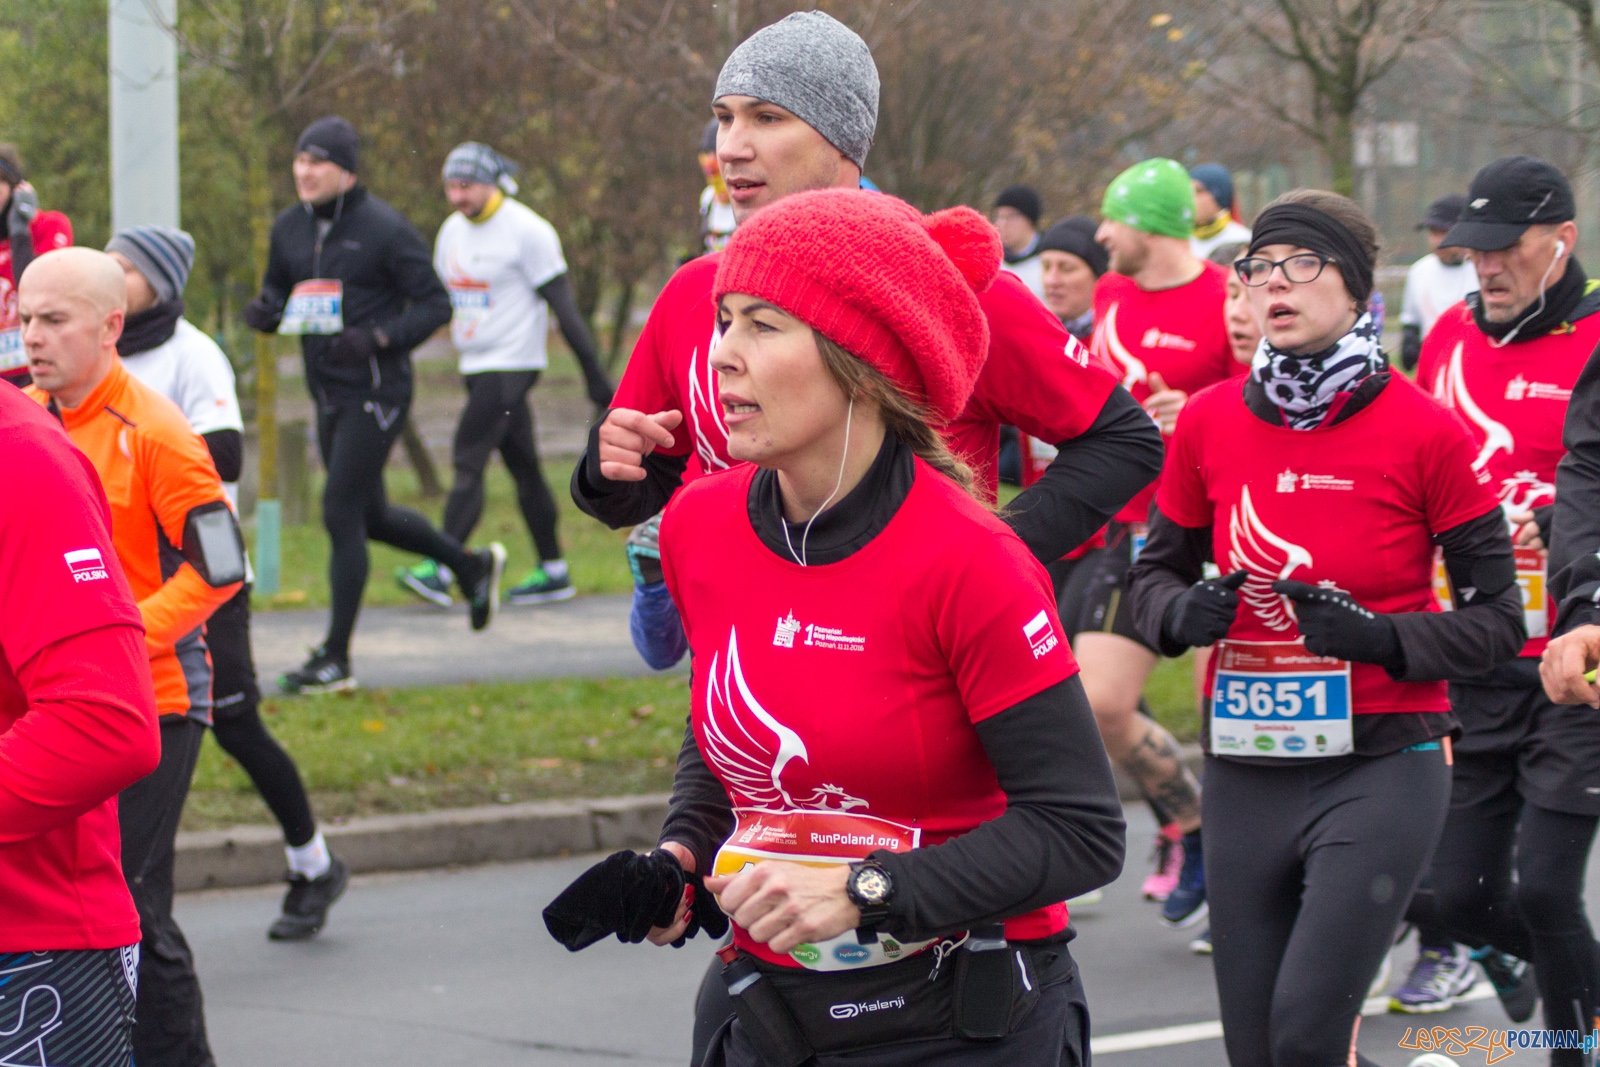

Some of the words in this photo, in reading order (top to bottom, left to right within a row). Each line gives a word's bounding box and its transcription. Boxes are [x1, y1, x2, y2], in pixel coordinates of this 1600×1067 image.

[73, 570, 109, 583] POLSKA
[1033, 635, 1059, 660] POLSKA
[1226, 680, 1327, 717] 5651
[810, 832, 899, 850] RunPoland.org
[859, 996, 905, 1013] Kalenji
